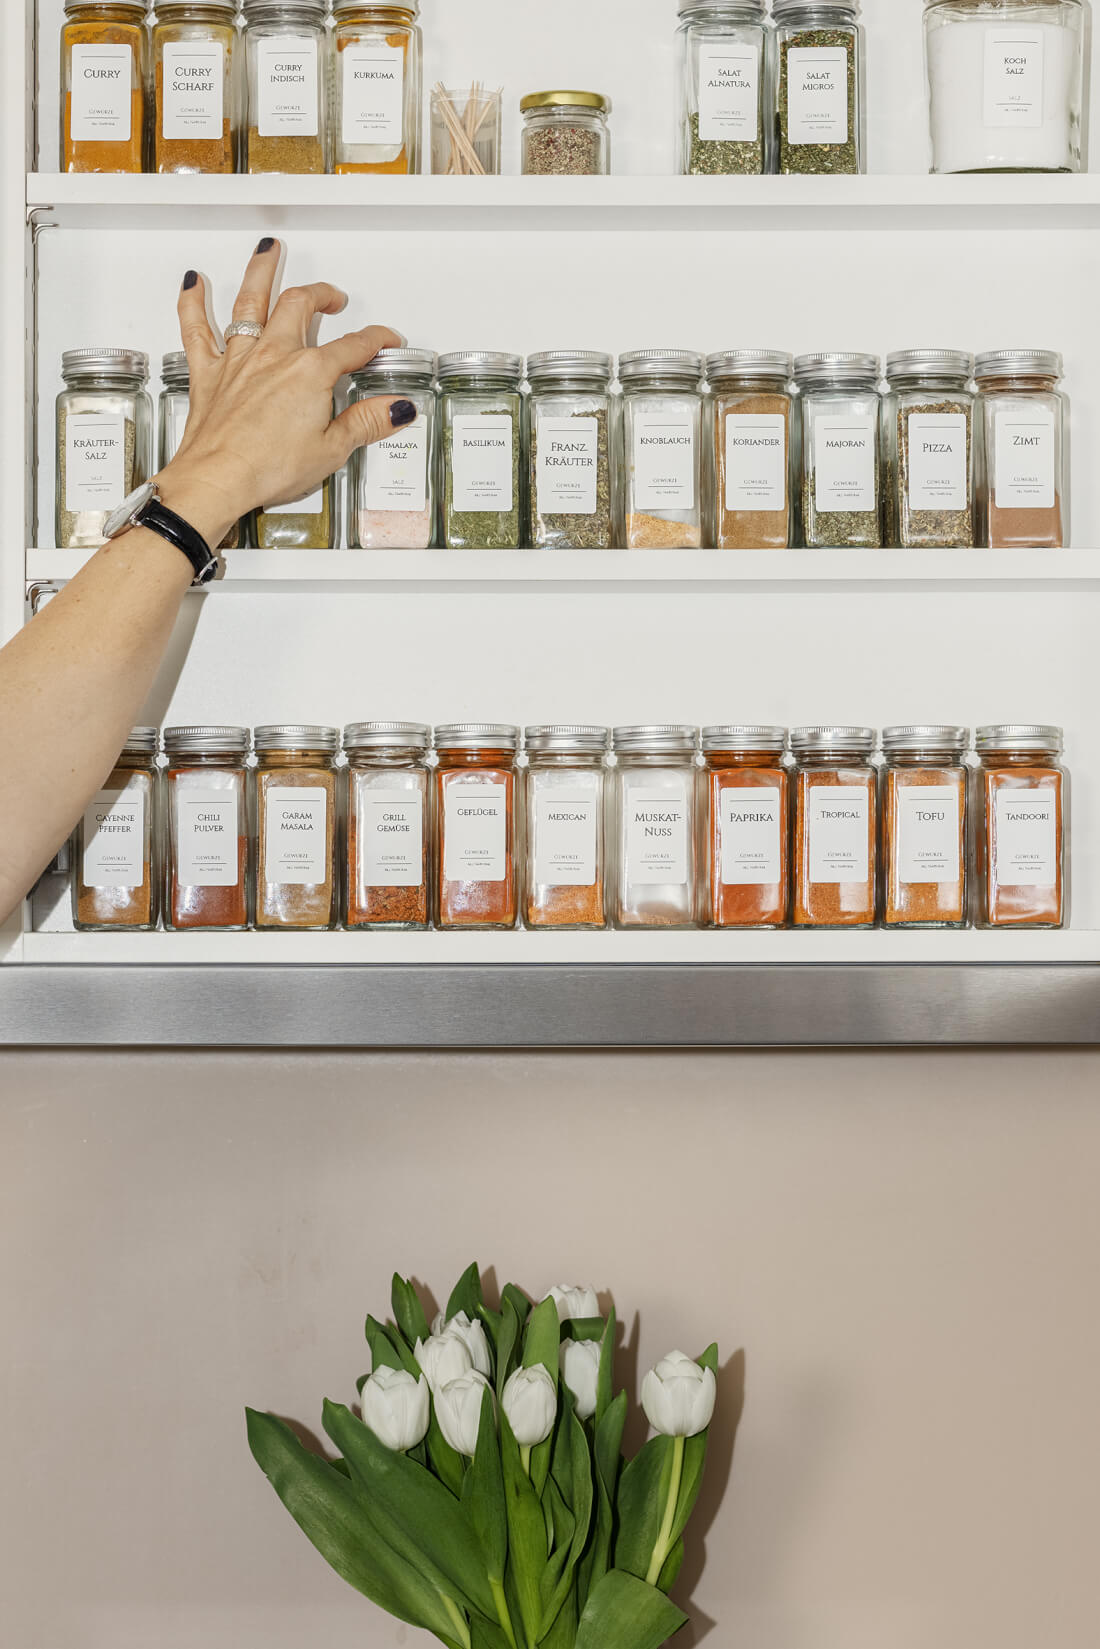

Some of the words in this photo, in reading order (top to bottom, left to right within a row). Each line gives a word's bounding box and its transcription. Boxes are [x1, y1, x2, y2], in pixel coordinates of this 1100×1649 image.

[1004, 57, 1027, 65] KOCH
[274, 63, 303, 72] CURRY
[1006, 67, 1024, 75] SALZ
[83, 68, 121, 79] CURRY
[175, 67, 212, 78] CURRY
[353, 71, 395, 79] KURKUMA
[717, 69, 742, 77] SALAT
[806, 72, 831, 80] SALAT
[270, 74, 305, 83] INDISCH
[172, 81, 215, 92] SCHARF
[707, 80, 751, 89] ALNATURA
[802, 82, 835, 91] MIGROS
[378, 441, 418, 449] HIMALAYA
[463, 439, 506, 447] BASILIKUM
[640, 437, 691, 445] KNOBLAUCH
[733, 438, 780, 446] KORIANDER
[825, 440, 865, 449] MAJORAN
[1013, 435, 1040, 447] ZIMT
[922, 443, 952, 453] PIZZA
[85, 451, 108, 460] SALZ
[389, 451, 407, 459] SALZ
[95, 814, 135, 822] CAYENNE
[197, 813, 220, 822] CHILI
[282, 811, 313, 820] GARAM
[382, 813, 407, 822] GRILL
[548, 813, 587, 821] MEXICAN
[730, 812, 774, 823] PAPRIKA
[820, 810, 861, 819] TROPICAL
[915, 812, 945, 822] TOFU
[1006, 813, 1049, 821] TANDOORI
[98, 825, 132, 833] PFEFFER
[194, 824, 224, 833] PULVER
[280, 822, 314, 831] MASALA
[644, 827, 672, 837] NUSS
